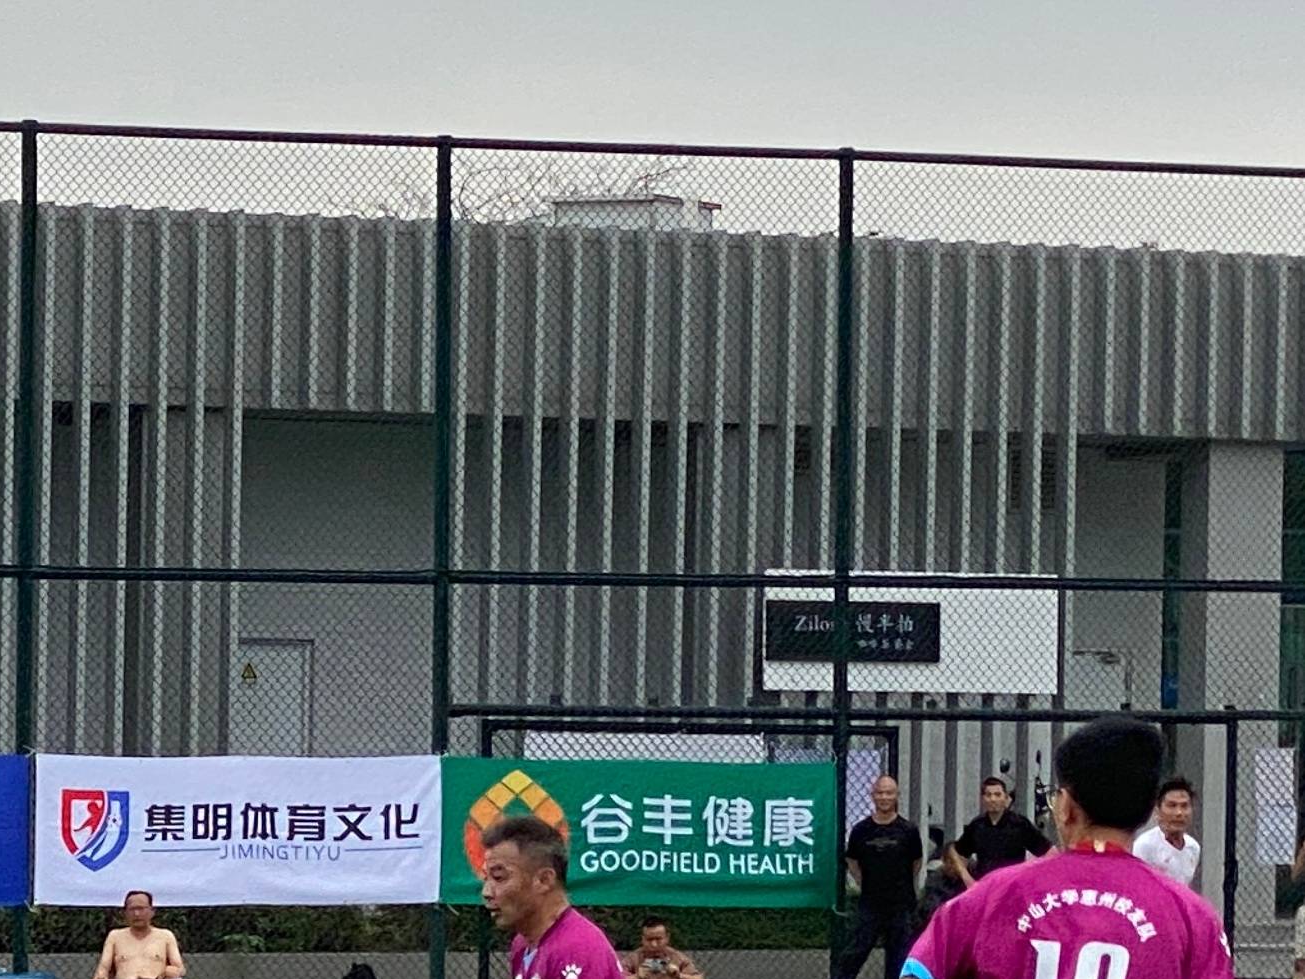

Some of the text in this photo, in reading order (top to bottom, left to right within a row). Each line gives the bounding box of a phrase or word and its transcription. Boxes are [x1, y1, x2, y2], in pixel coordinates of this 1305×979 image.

[144, 803, 420, 841] 集明体育文化
[580, 793, 815, 847] 谷丰健康
[219, 844, 341, 860] JIMINGTIYU
[580, 850, 814, 875] GOODFIELD HEALTH
